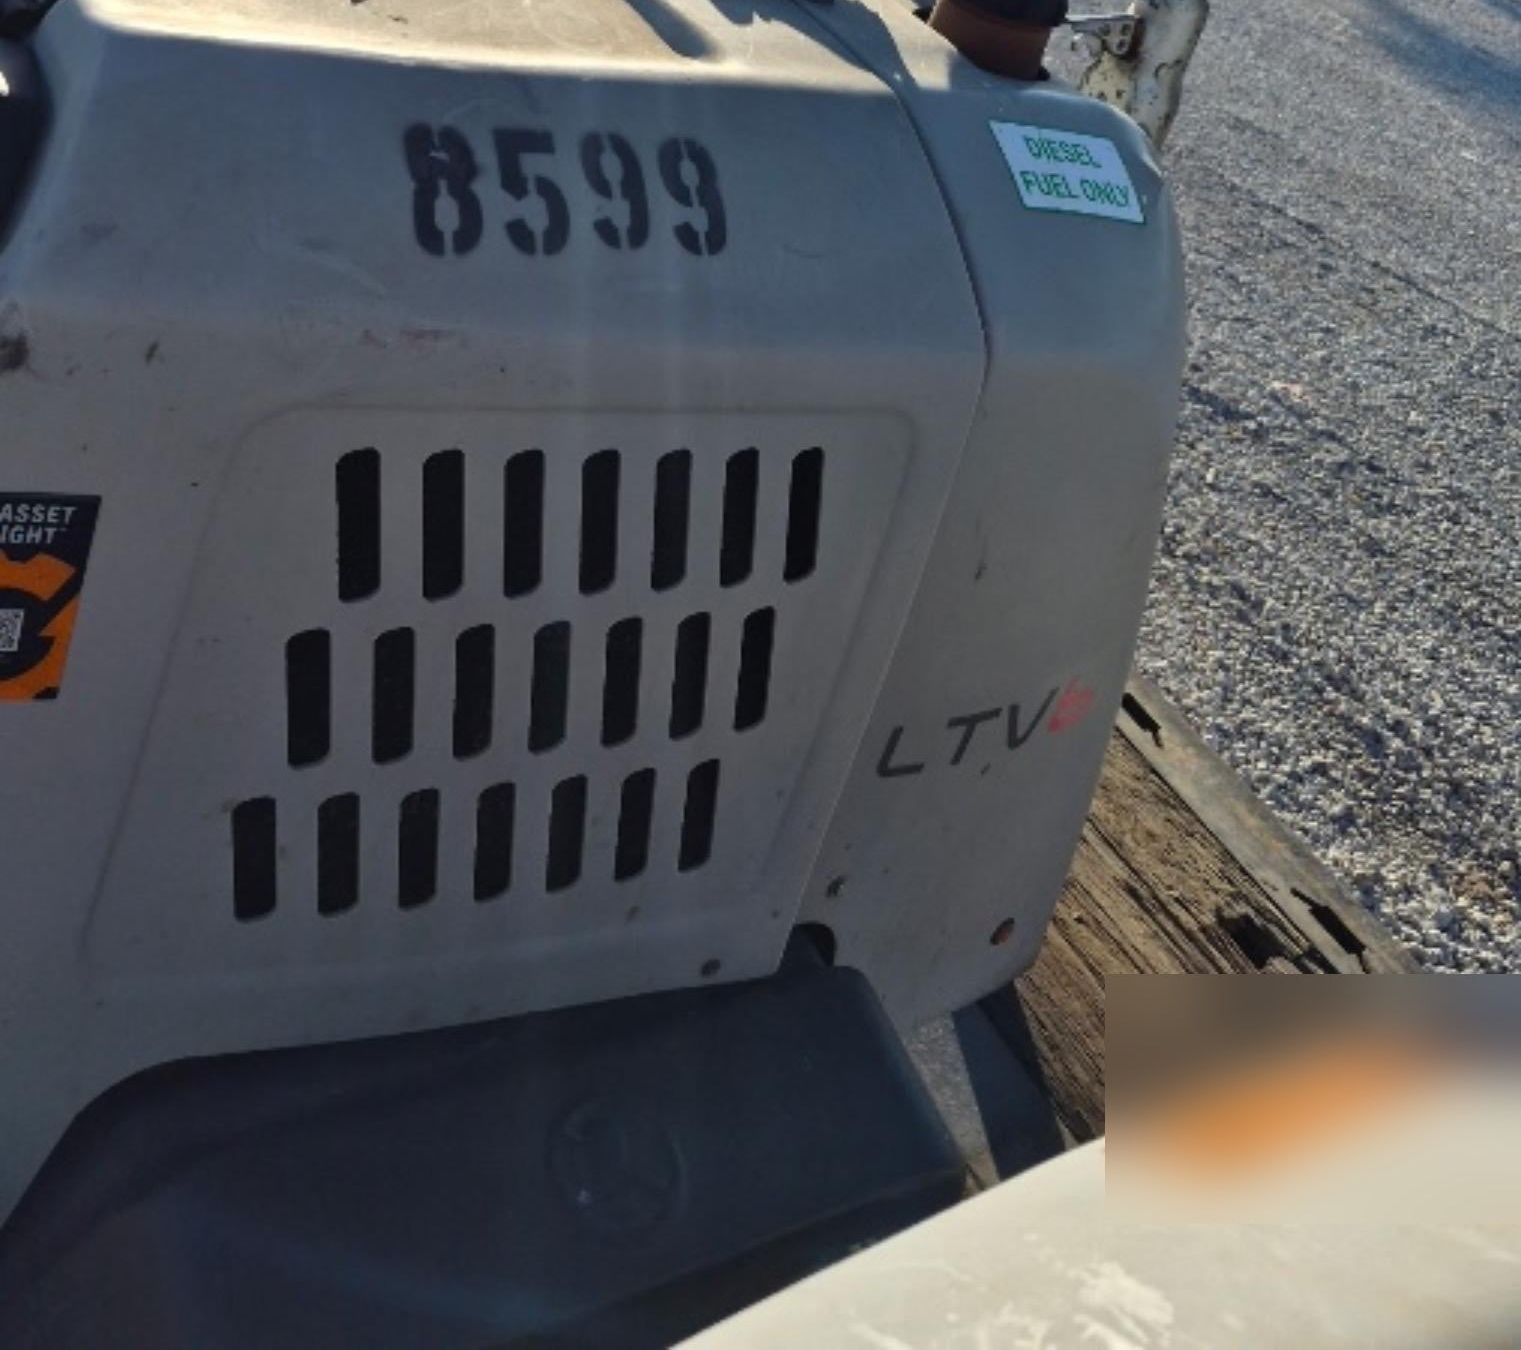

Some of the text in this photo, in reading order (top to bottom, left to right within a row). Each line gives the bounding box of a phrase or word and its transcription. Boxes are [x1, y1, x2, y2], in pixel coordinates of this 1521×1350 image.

[1023, 135, 1102, 168] DIESEL
[403, 121, 728, 258] 8599
[1019, 170, 1130, 207] FUEL ONLY
[0, 503, 78, 525] ASSET
